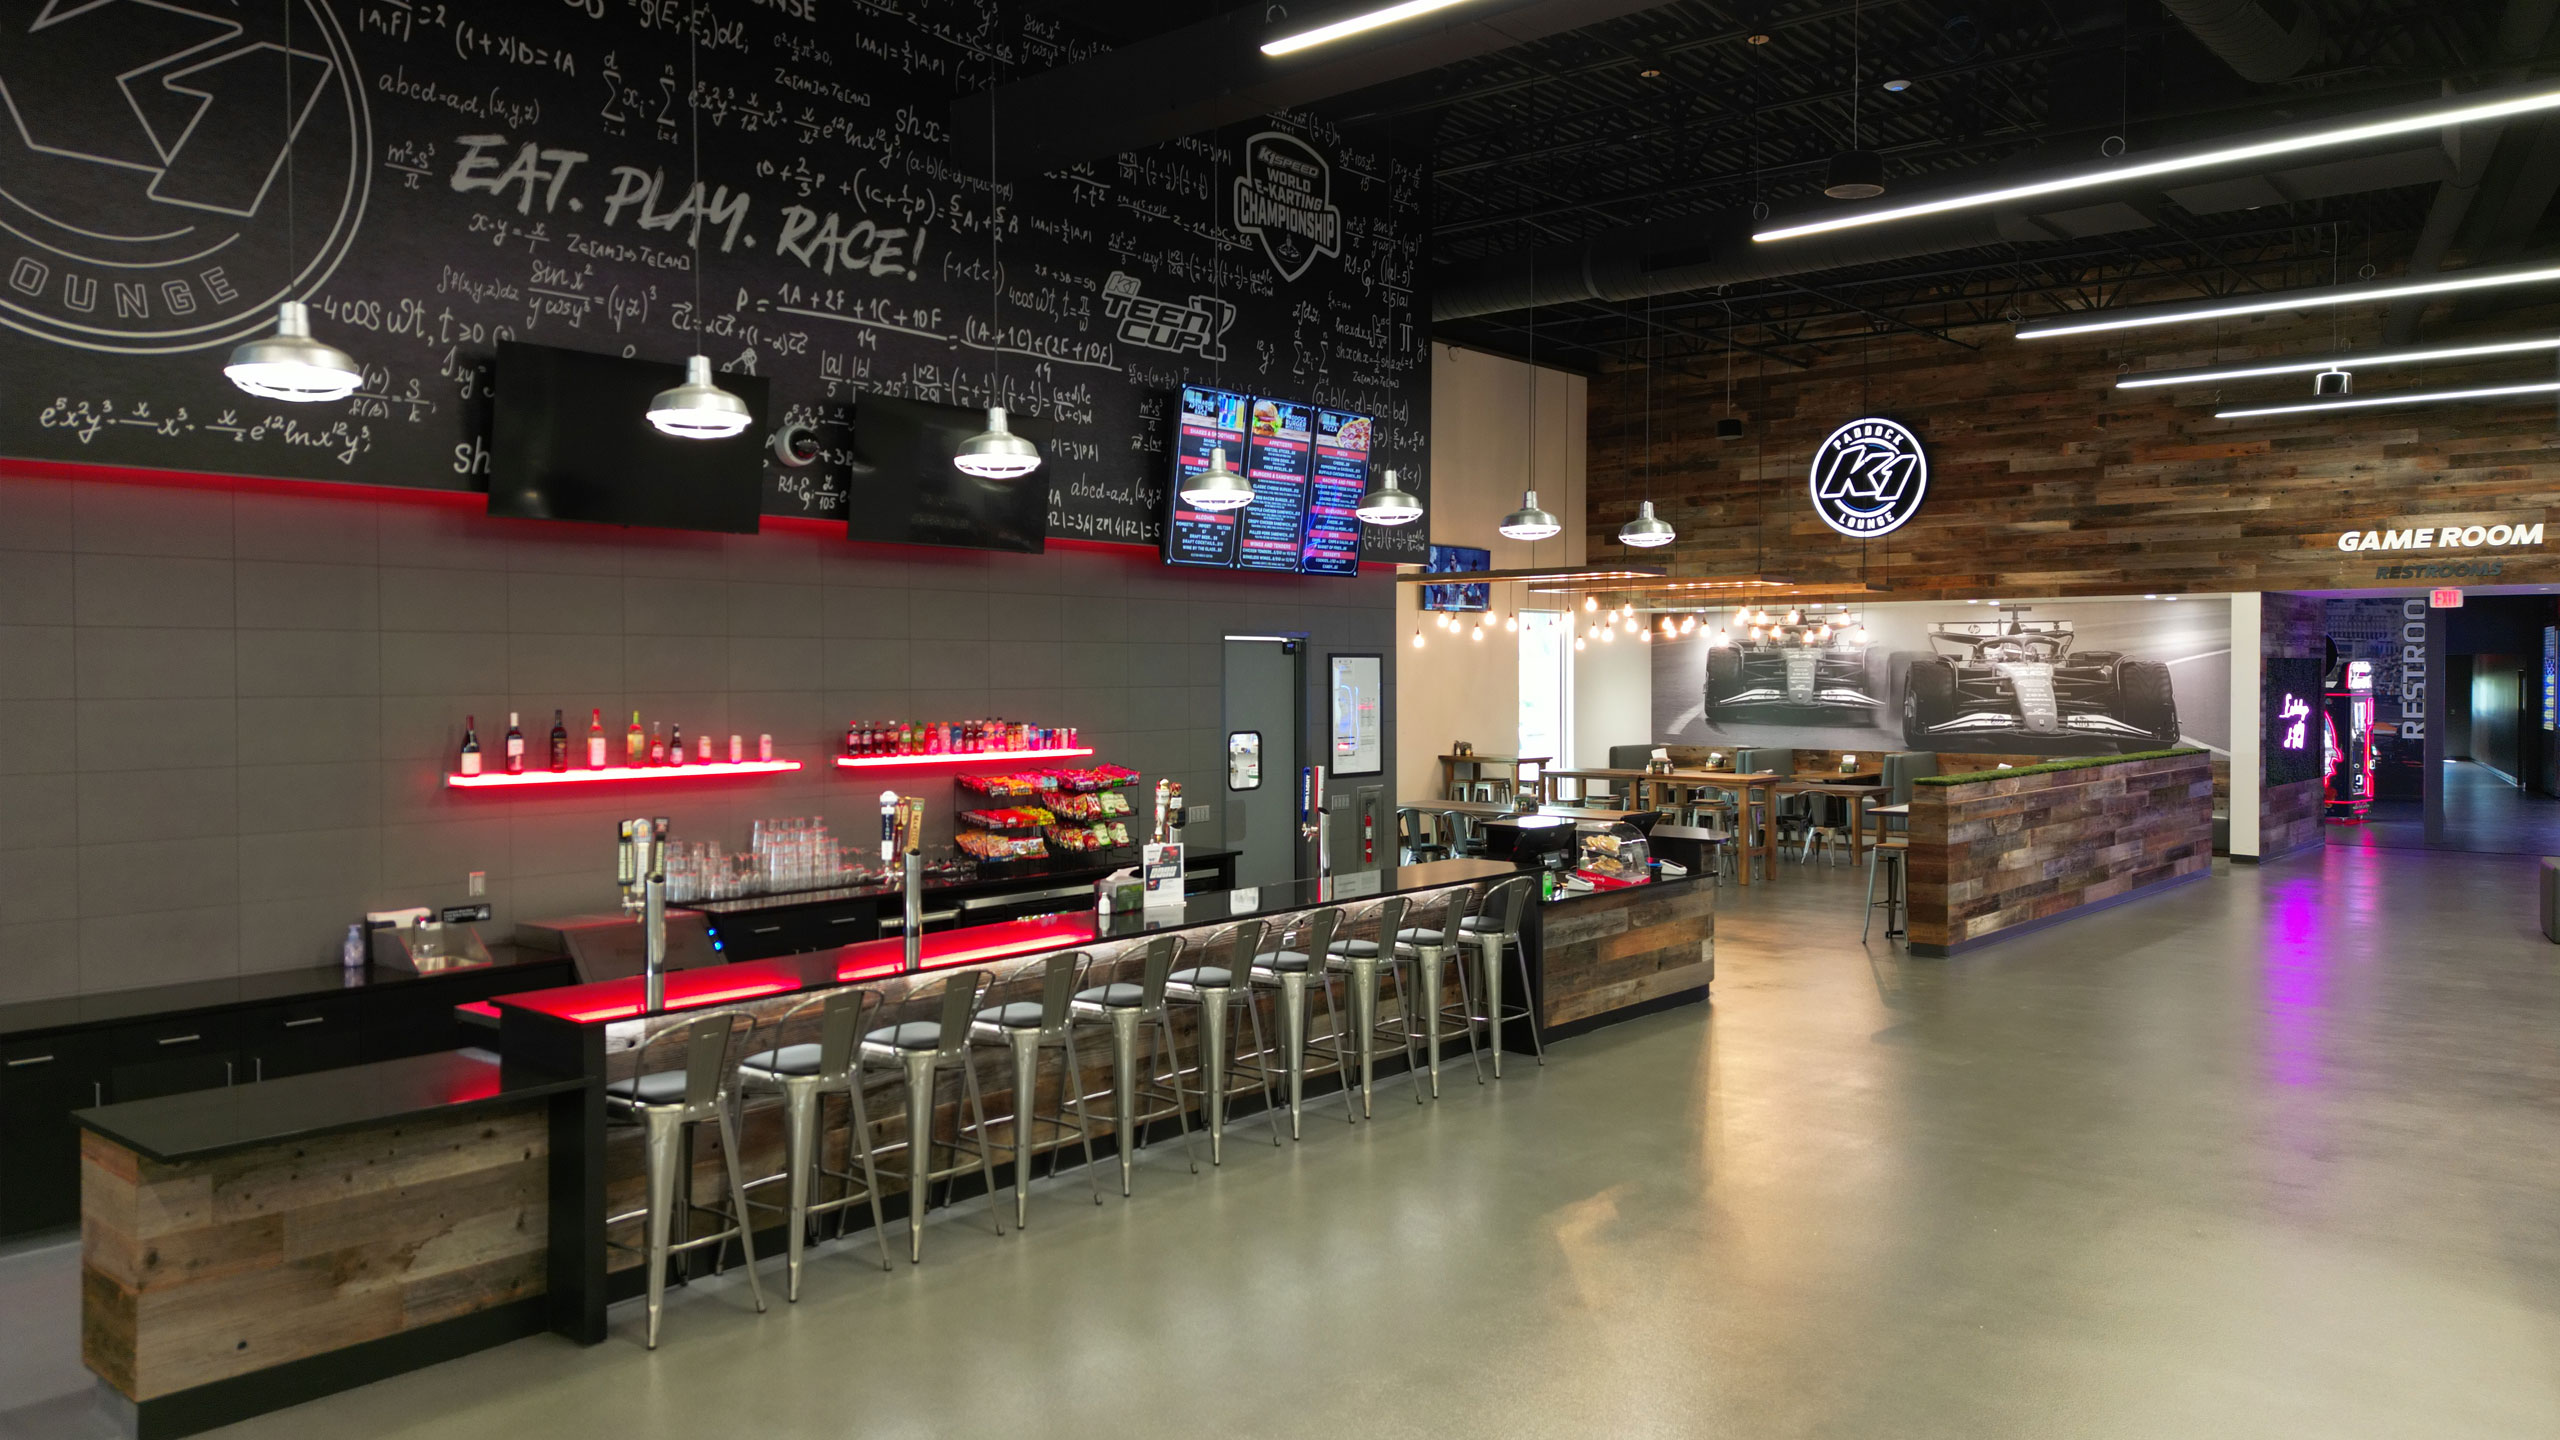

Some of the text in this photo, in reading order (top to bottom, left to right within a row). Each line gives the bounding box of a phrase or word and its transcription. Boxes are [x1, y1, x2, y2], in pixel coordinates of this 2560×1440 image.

[450, 134, 589, 215] EAT.
[1267, 167, 1311, 193] WORLD
[603, 165, 757, 253] PLAY.
[1254, 178, 1323, 212] E-KARTING
[1240, 185, 1336, 247] CHAMPIONSHIP
[776, 204, 927, 282] RACE!
[9, 256, 239, 318] OUNGE
[1102, 293, 1212, 333] TEEN
[1119, 320, 1204, 353] CUP
[1832, 425, 1904, 450] PADDOCK
[1820, 445, 1917, 501] K1
[1838, 511, 1896, 530] LOUNGE
[2338, 523, 2544, 551] GAME ROOM
[2376, 562, 2504, 580] RESTROOMS
[2434, 591, 2459, 607] EXIT
[2401, 599, 2425, 739] RESTROO
